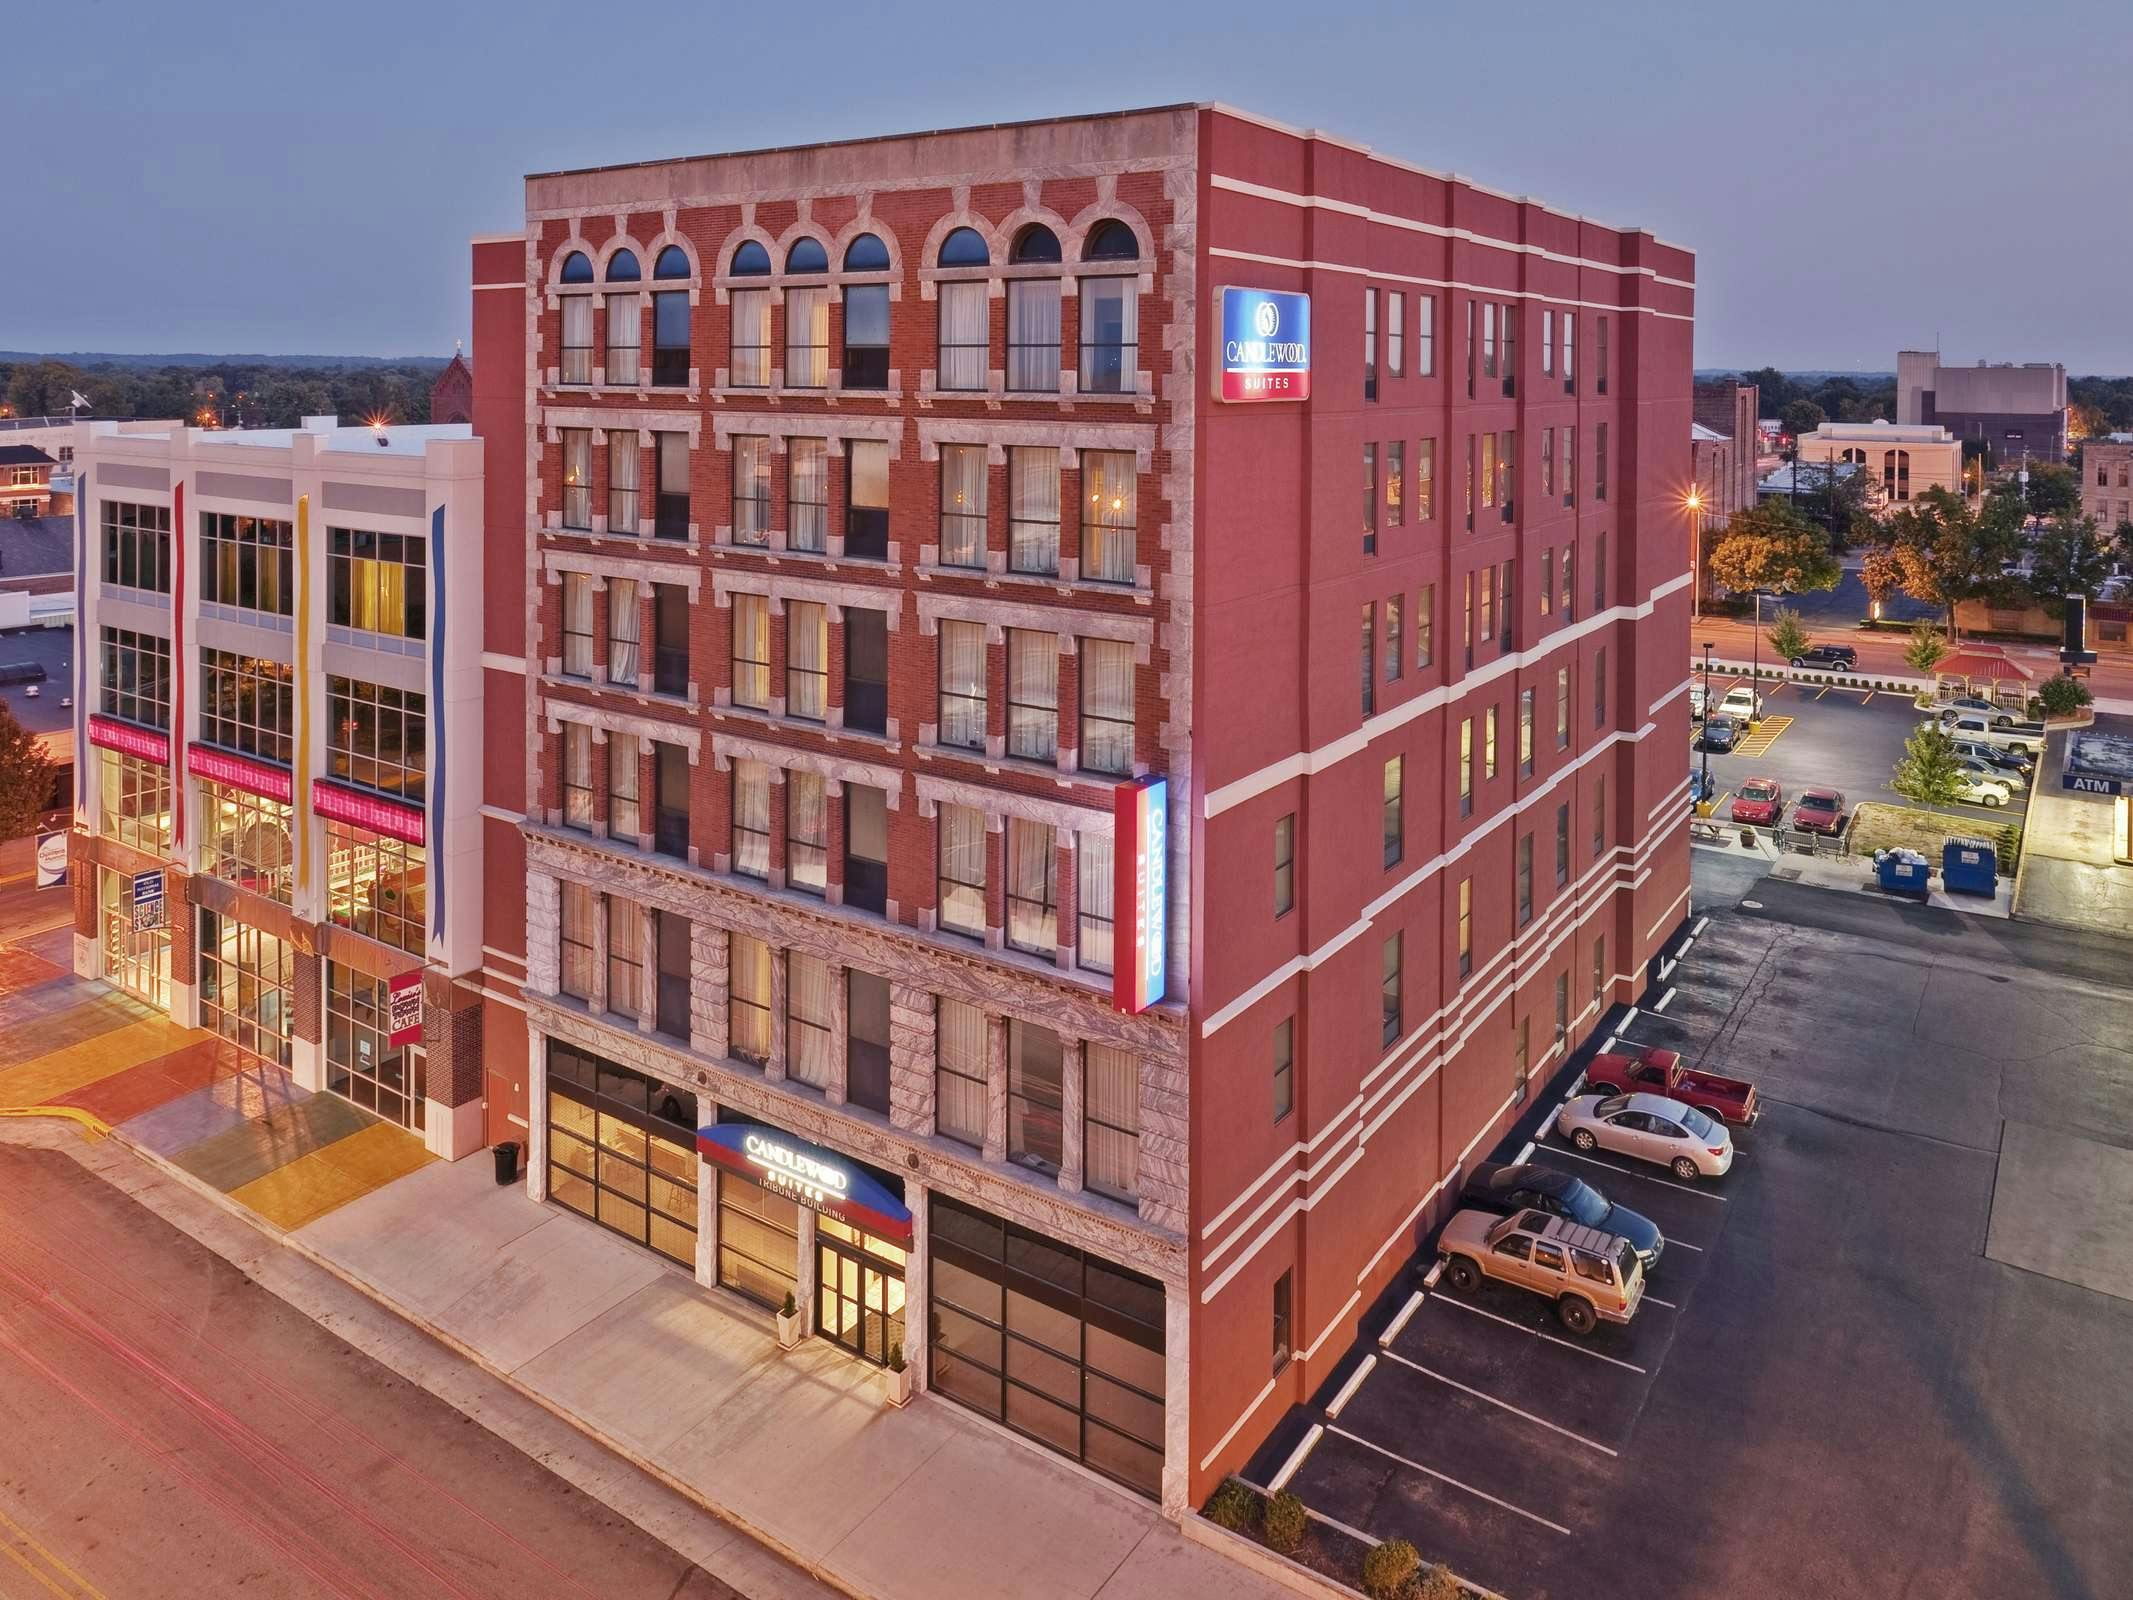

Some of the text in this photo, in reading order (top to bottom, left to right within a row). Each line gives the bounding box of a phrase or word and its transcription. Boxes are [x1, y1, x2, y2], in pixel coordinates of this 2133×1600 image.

[1226, 341, 1307, 363] CANDLEWOOD
[1245, 377, 1289, 390] SUITES
[2073, 778, 2110, 793] ATM
[134, 900, 163, 918] SCIENCE
[746, 1135, 847, 1190] CANDLEWOOD
[767, 1171, 824, 1202] SUITES
[759, 1177, 846, 1222] TRIBUNE BUILDING
